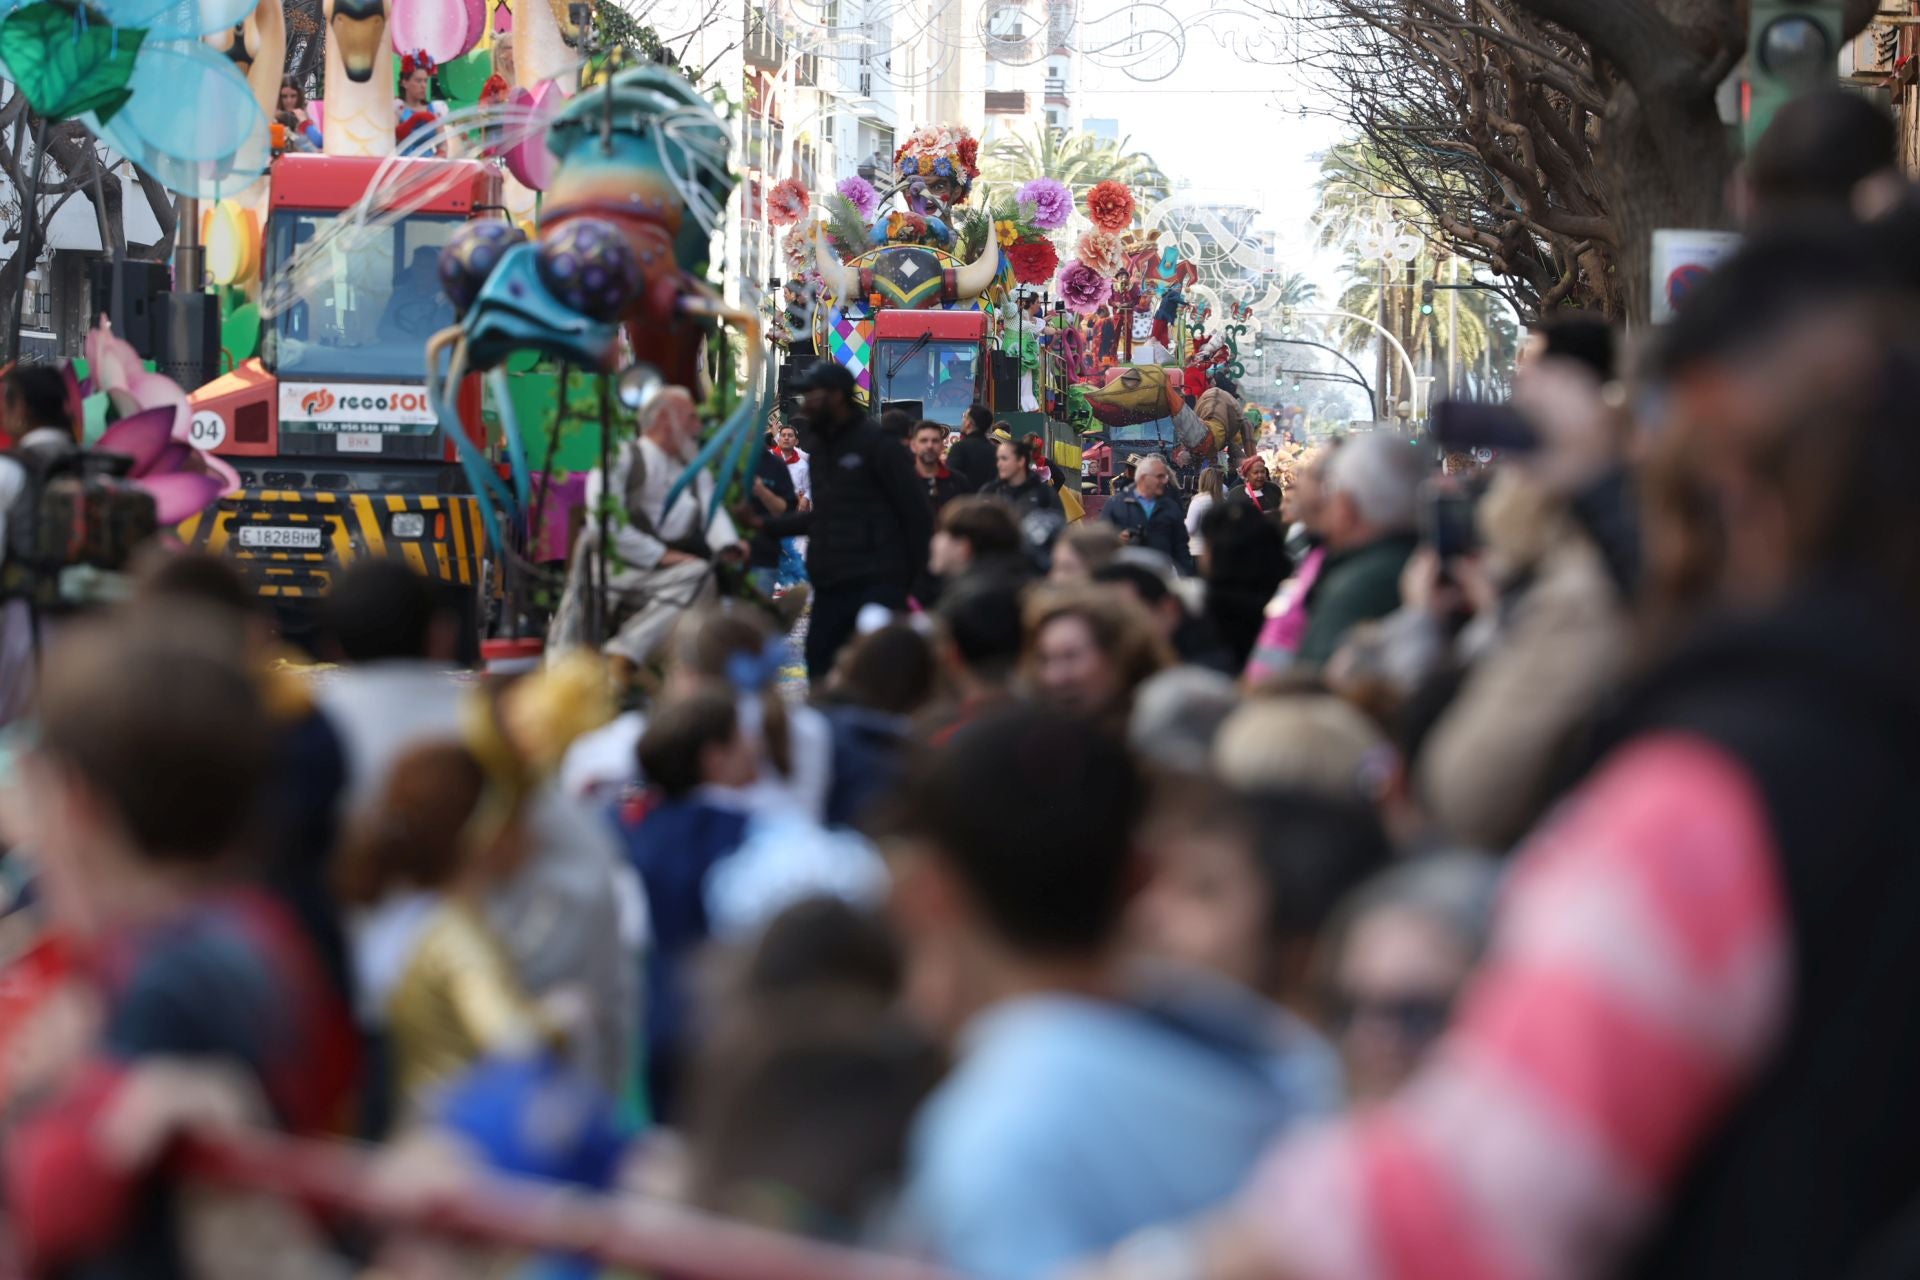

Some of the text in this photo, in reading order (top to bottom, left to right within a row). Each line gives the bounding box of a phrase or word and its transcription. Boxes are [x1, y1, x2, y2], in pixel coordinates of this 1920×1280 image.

[191, 419, 220, 441] 04
[1479, 450, 1490, 458] 50
[243, 529, 252, 545] E
